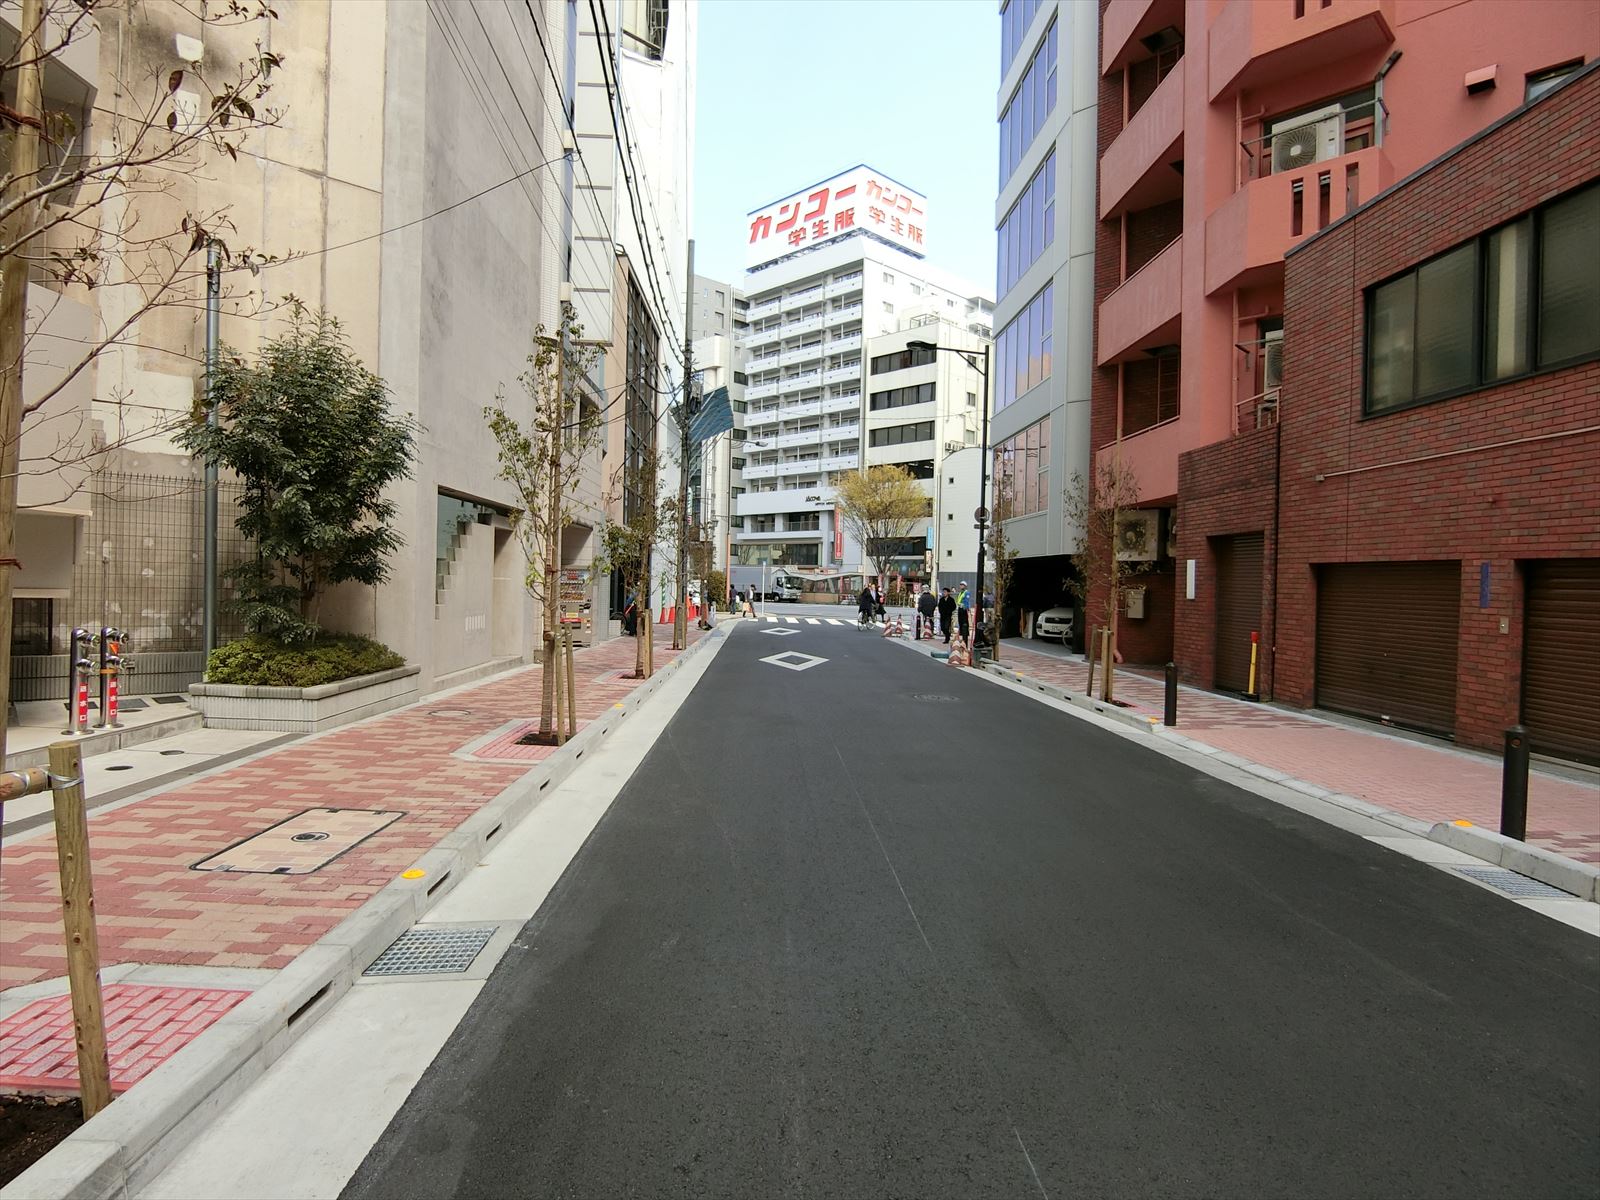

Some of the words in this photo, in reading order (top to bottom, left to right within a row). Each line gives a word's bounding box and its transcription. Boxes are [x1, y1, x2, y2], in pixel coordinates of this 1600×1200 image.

[749, 184, 857, 244] カンコー
[866, 179, 924, 216] カンコー
[788, 207, 855, 247] 学生服
[868, 205, 924, 245] 学生服
